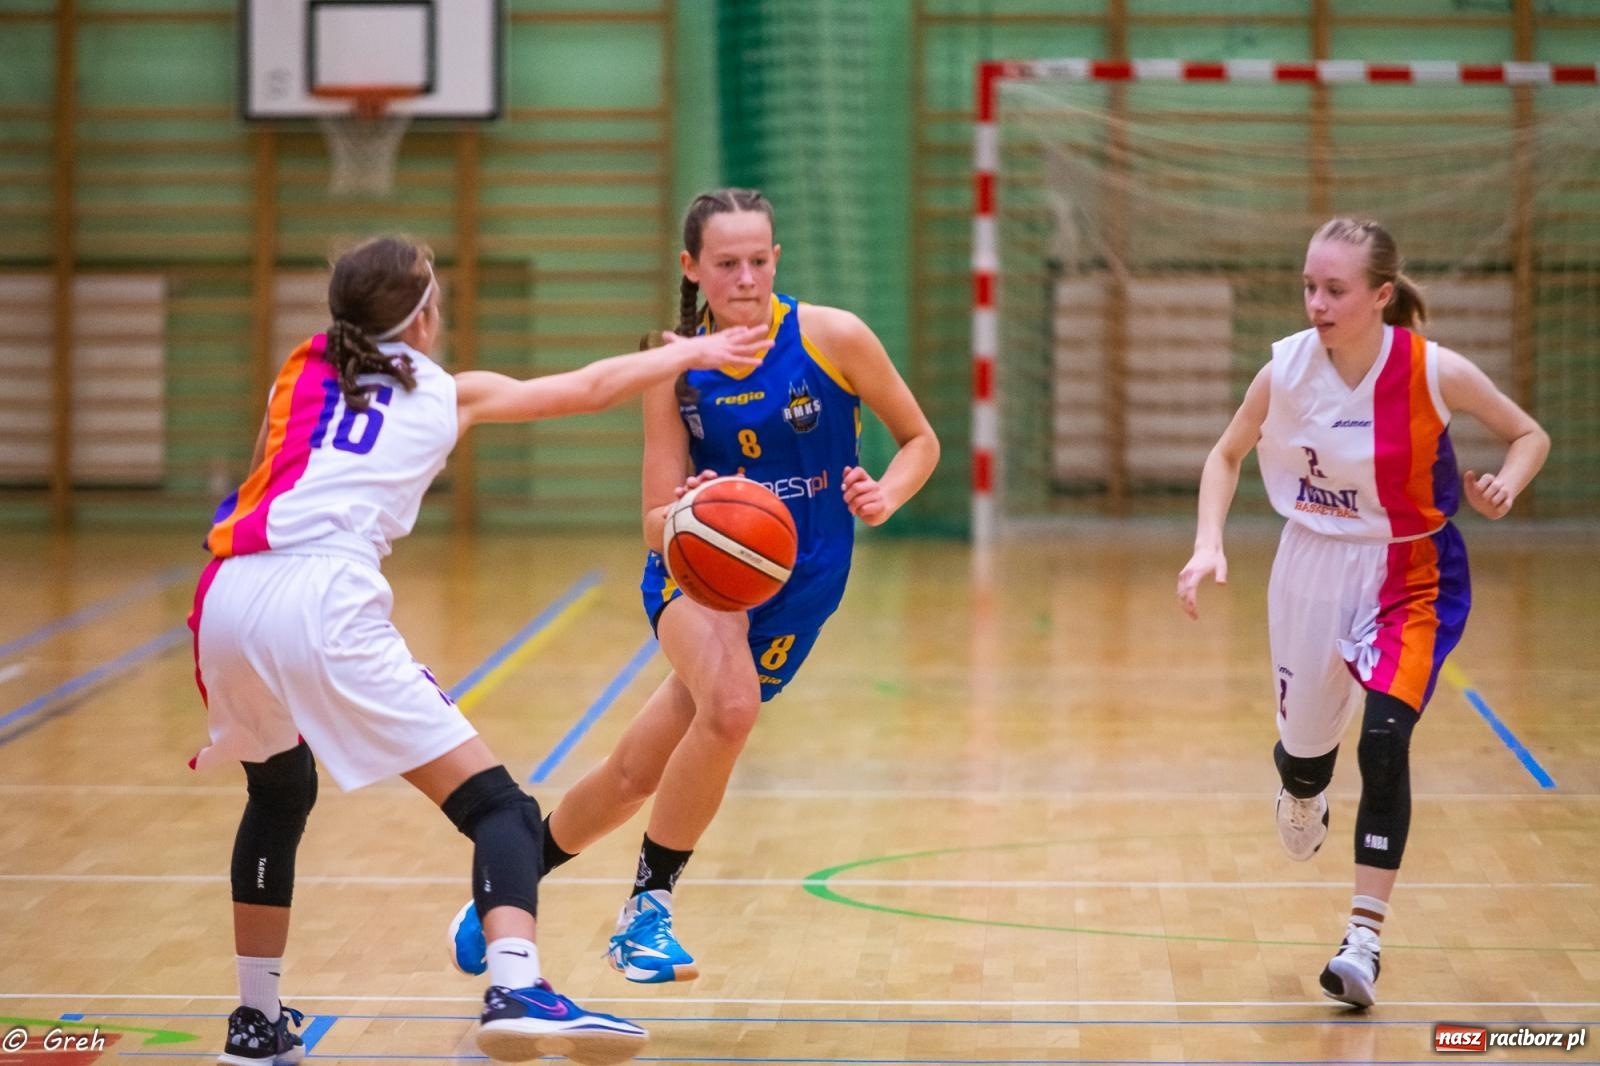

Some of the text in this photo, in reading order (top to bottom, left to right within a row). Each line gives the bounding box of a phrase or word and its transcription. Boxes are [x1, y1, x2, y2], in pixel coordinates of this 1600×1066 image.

[715, 391, 765, 406] regio
[783, 399, 822, 420] RMKS
[309, 378, 393, 455] 16
[738, 429, 762, 458] 8
[1301, 446, 1328, 478] 2
[760, 634, 796, 670] 8
[257, 857, 267, 888] TARMAK
